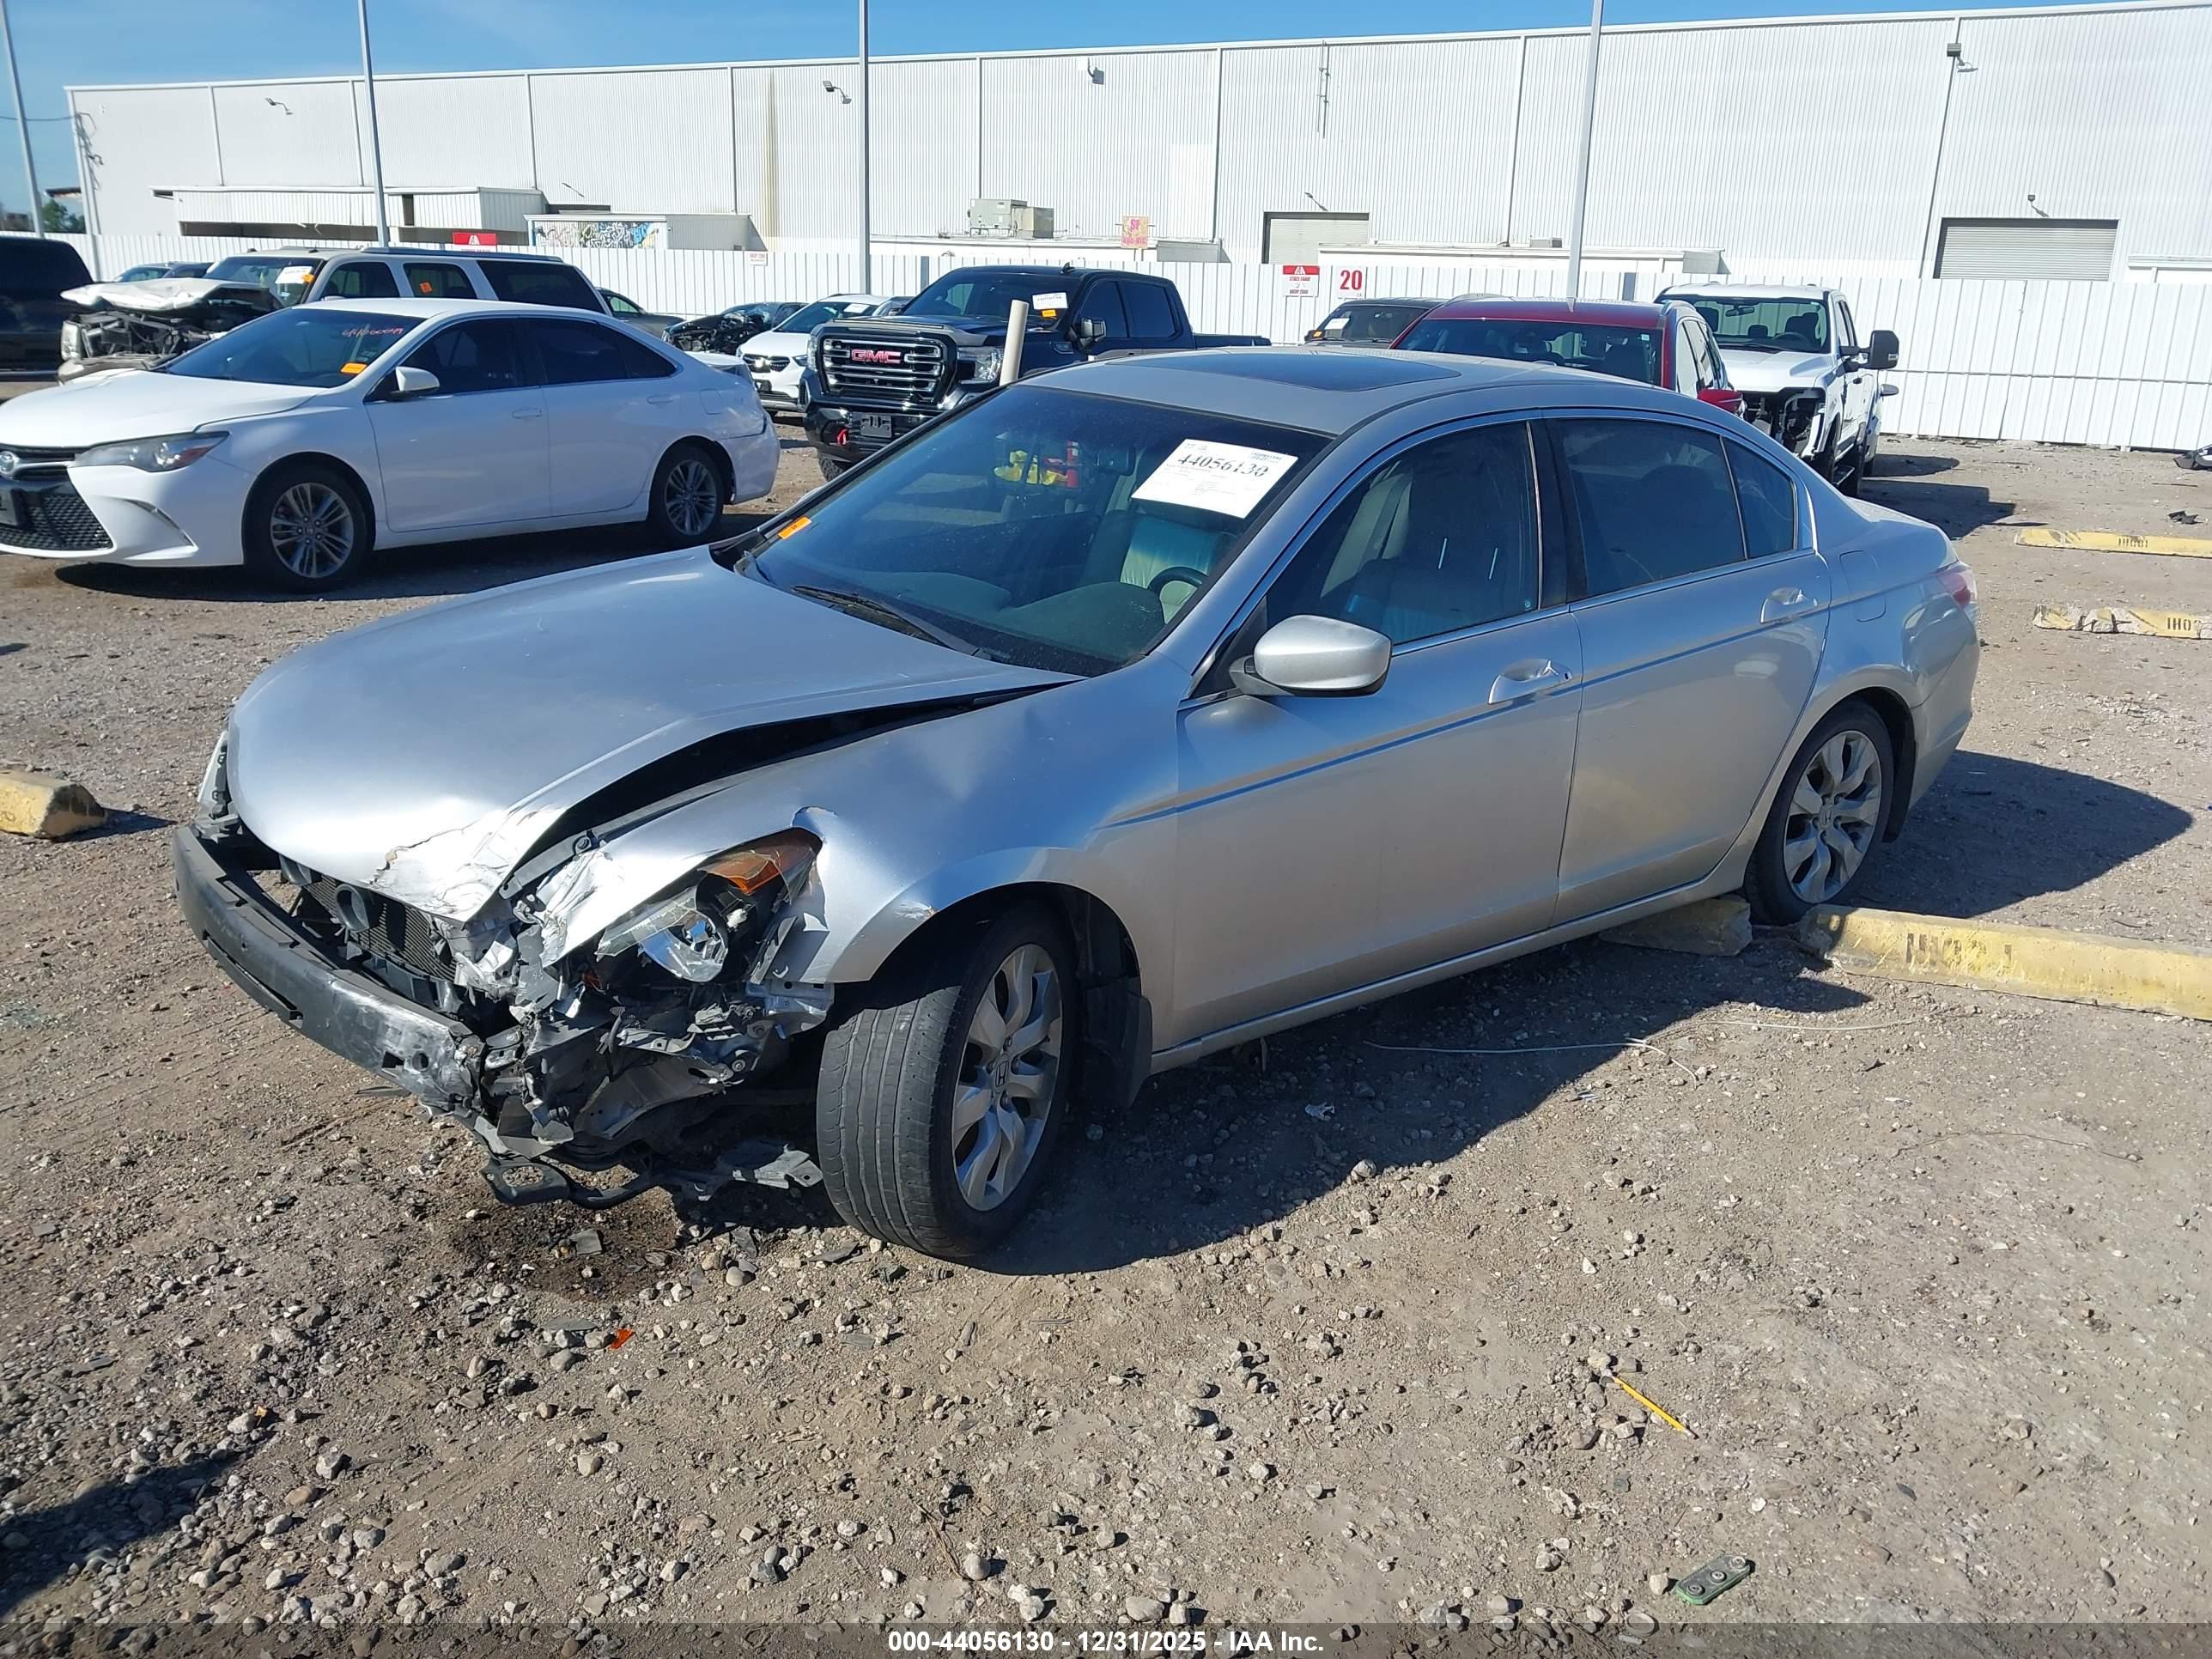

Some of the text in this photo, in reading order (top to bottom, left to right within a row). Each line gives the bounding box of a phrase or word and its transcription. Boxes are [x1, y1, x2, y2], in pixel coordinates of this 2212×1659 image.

[1340, 270, 1363, 290] 20
[851, 349, 902, 364] GMC
[1177, 453, 1270, 478] 44056130
